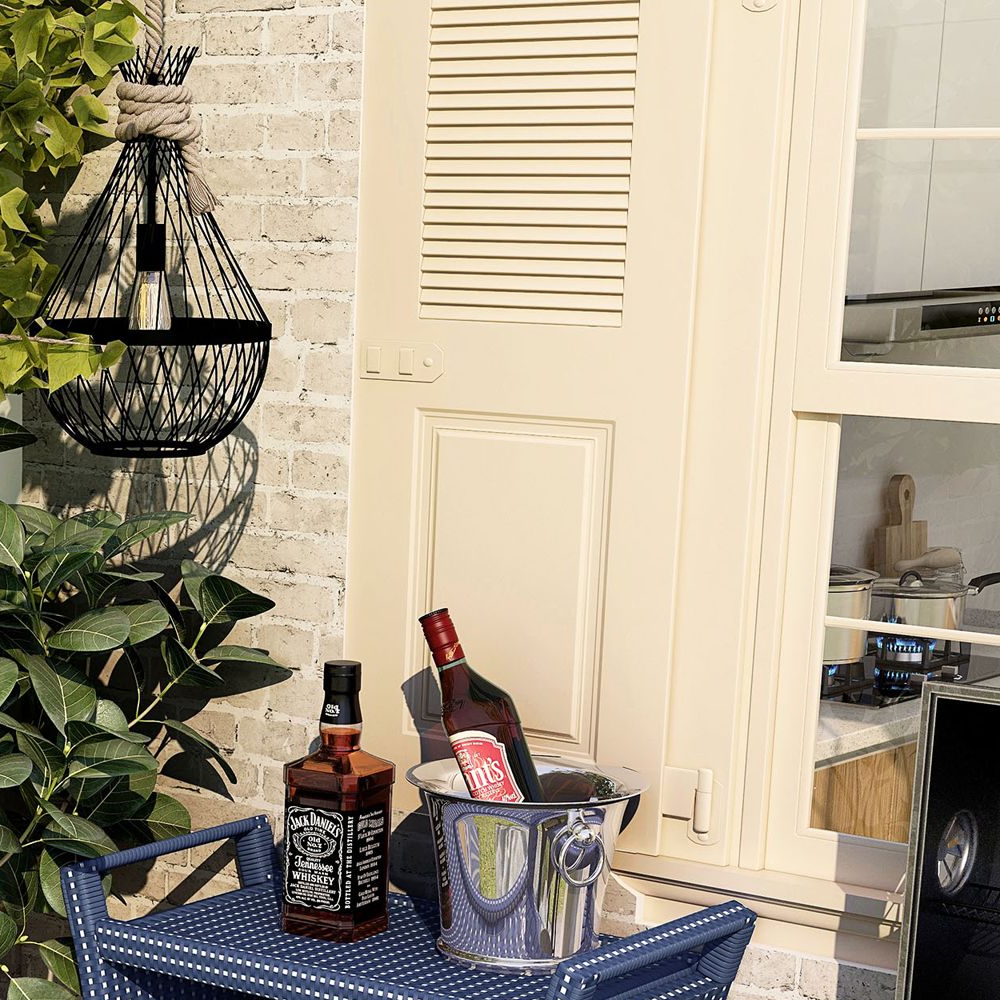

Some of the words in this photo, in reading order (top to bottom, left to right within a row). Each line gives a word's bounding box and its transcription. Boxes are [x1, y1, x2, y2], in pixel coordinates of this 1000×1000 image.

[290, 815, 310, 831] JACK
[310, 811, 341, 838] DANIEL'S
[346, 815, 354, 854] DISTILLERY
[294, 855, 334, 873] Tennessee
[345, 855, 353, 869] THE
[292, 870, 335, 886] WHISKEY
[345, 870, 352, 879] AT
[344, 880, 352, 909] BOTTLED
